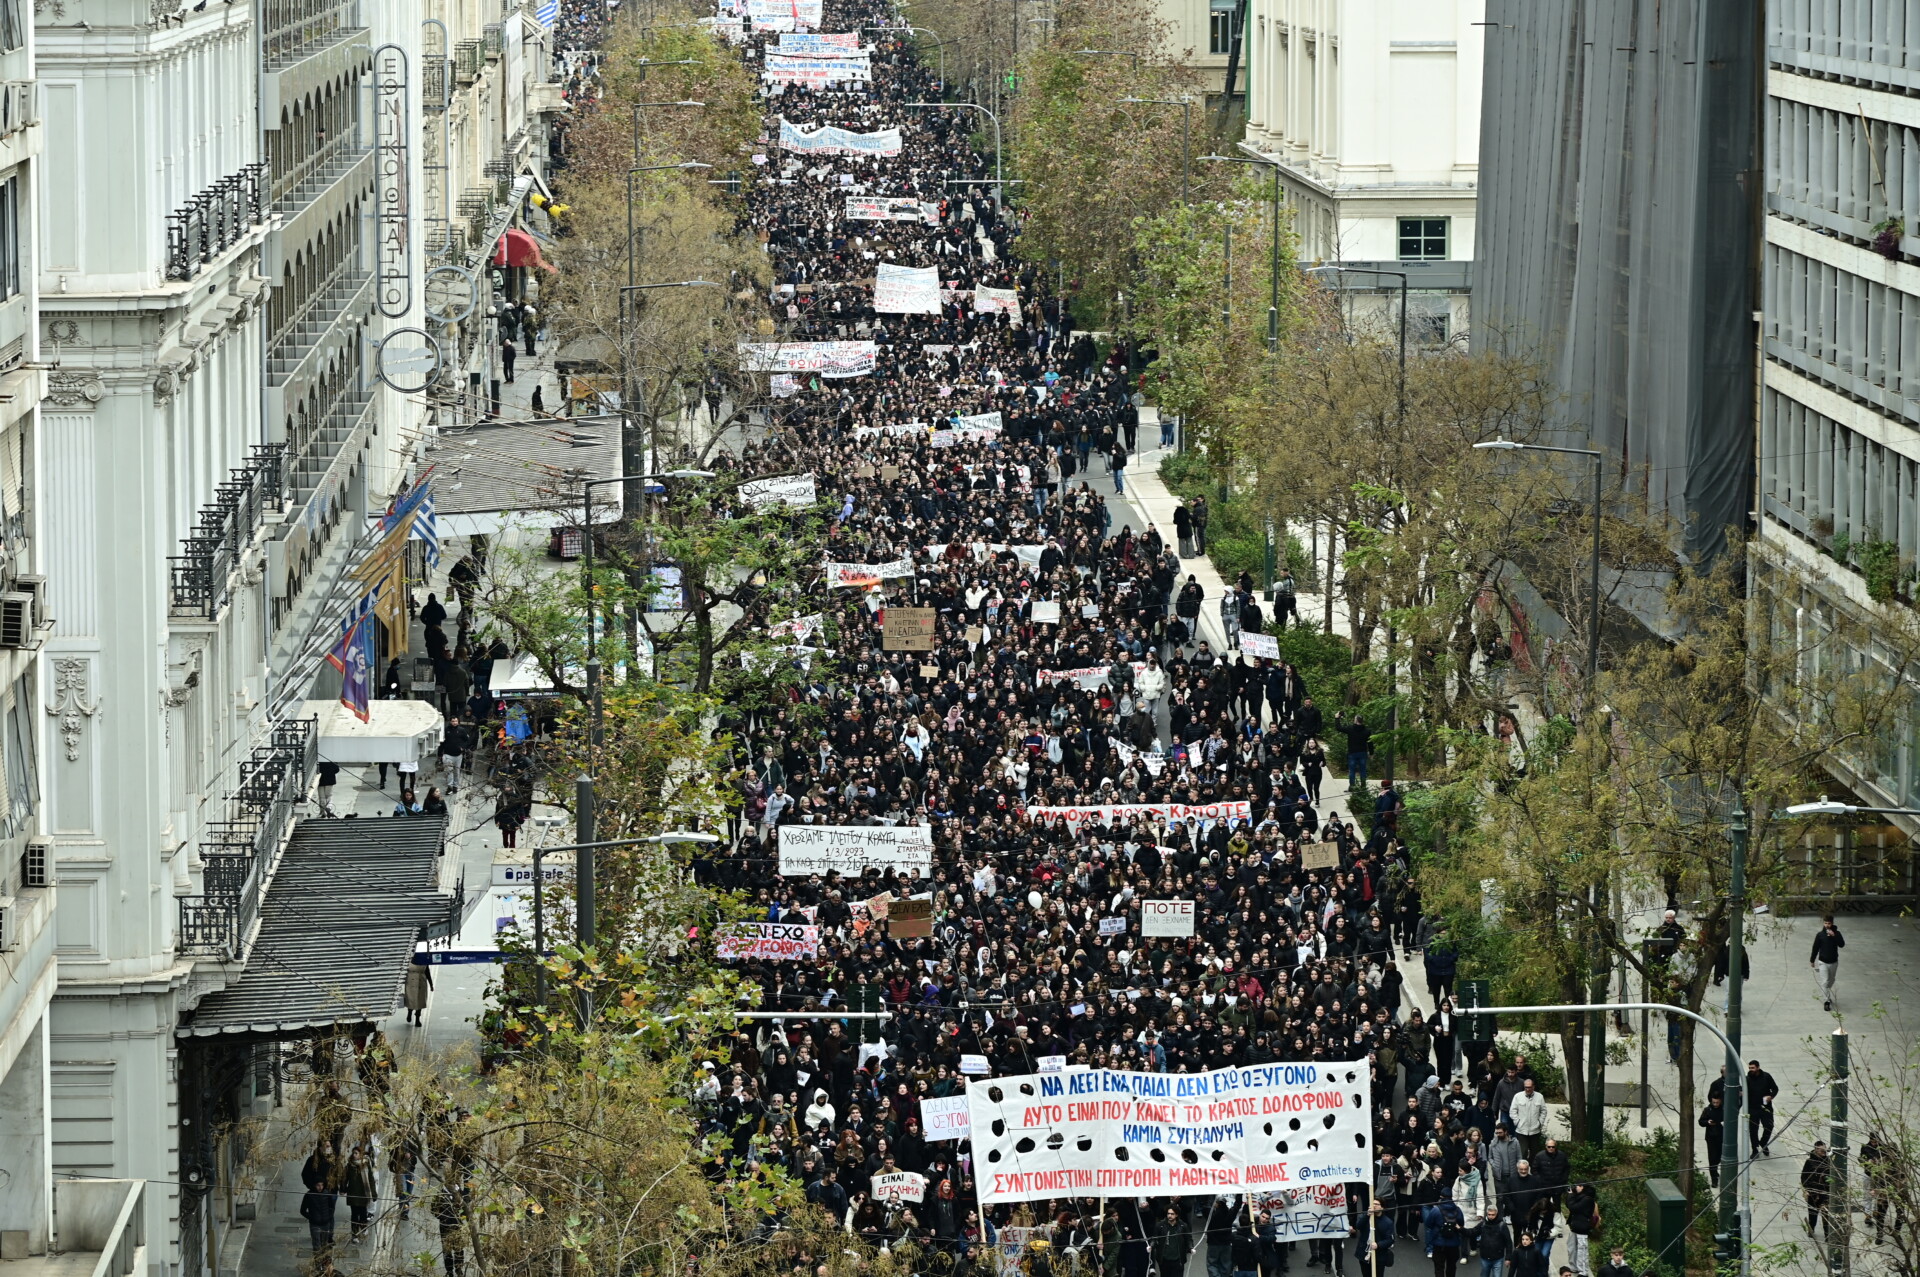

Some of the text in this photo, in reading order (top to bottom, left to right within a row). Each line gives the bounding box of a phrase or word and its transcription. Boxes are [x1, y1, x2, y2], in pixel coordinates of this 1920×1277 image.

[1170, 803, 1246, 818] ΚΑΠΟΤΕ
[826, 848, 864, 857] 1/3/2023
[1308, 845, 1330, 855] ΔΕΝ
[902, 860, 926, 868] ΤΕΜΠΗ
[892, 904, 908, 914] ΔΕΝ
[1144, 902, 1192, 914] ΠΟΤΕ
[1145, 916, 1158, 924] ΔΕΝ
[772, 925, 804, 941] ΕΧΩ
[1040, 1065, 1317, 1097] ΝΑ ΛΕΕΙ ΕΝΑ ΠΑΙΔΙ ΔΕΝ ΕΧΩ ΟΞΥΓΟΝΟ
[926, 1098, 948, 1114] ΔΕΝ
[1024, 1091, 1344, 1128] ΑΥΤΟ ΕΙΝΑΙ ΠΟΥ ΚΑΝΕΙ ΤΟ ΚΡΑΤΟΣ ΔΟΛΟΦΟΝΟ
[1124, 1122, 1244, 1145] ΚΑΜΙΑ ΣΥΓΚΑΛΥΨΗ
[882, 1174, 904, 1184] ΕΙΝΑΙ
[994, 1162, 1290, 1194] ΣΥΝΤΟΝΙΣΤΙΚΗ ΕΠΙΤΡΟΠΗ ΜΑΘΗΤΩΝ ΑΘΗΝΑΣ
[1298, 1165, 1362, 1182] @mathites.gr
[878, 1184, 920, 1196] ΕΓΚΛΗΜΑ
[1294, 1194, 1312, 1206] ΔΕΝ
